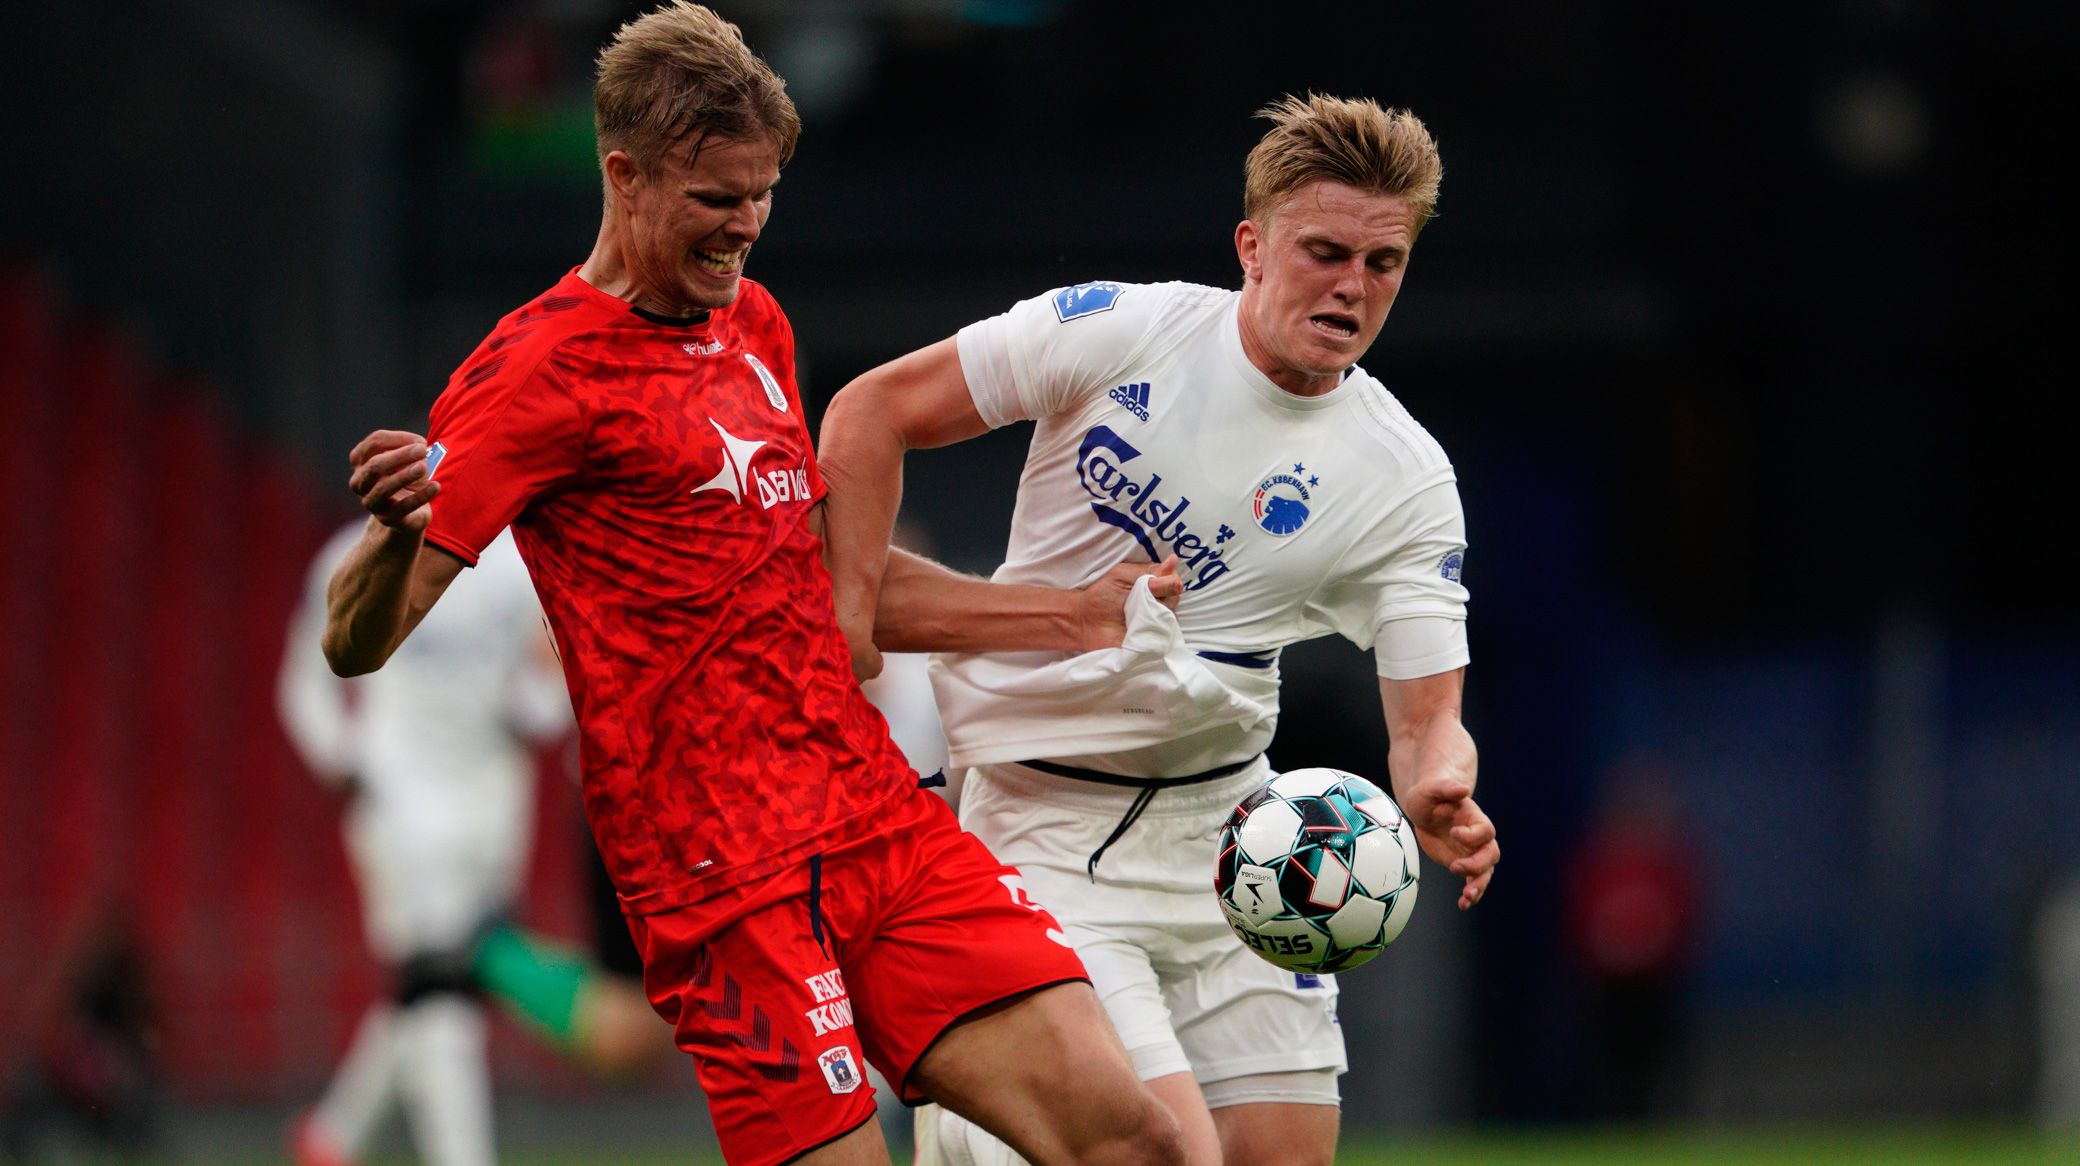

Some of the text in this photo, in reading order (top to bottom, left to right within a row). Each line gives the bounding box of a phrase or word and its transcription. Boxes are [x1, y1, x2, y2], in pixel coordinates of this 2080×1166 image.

[1109, 388, 1150, 422] adidas
[1076, 424, 1231, 592] Carlsberg
[1241, 871, 1272, 882] SUPERLIGA
[1226, 916, 1314, 956] SELEC
